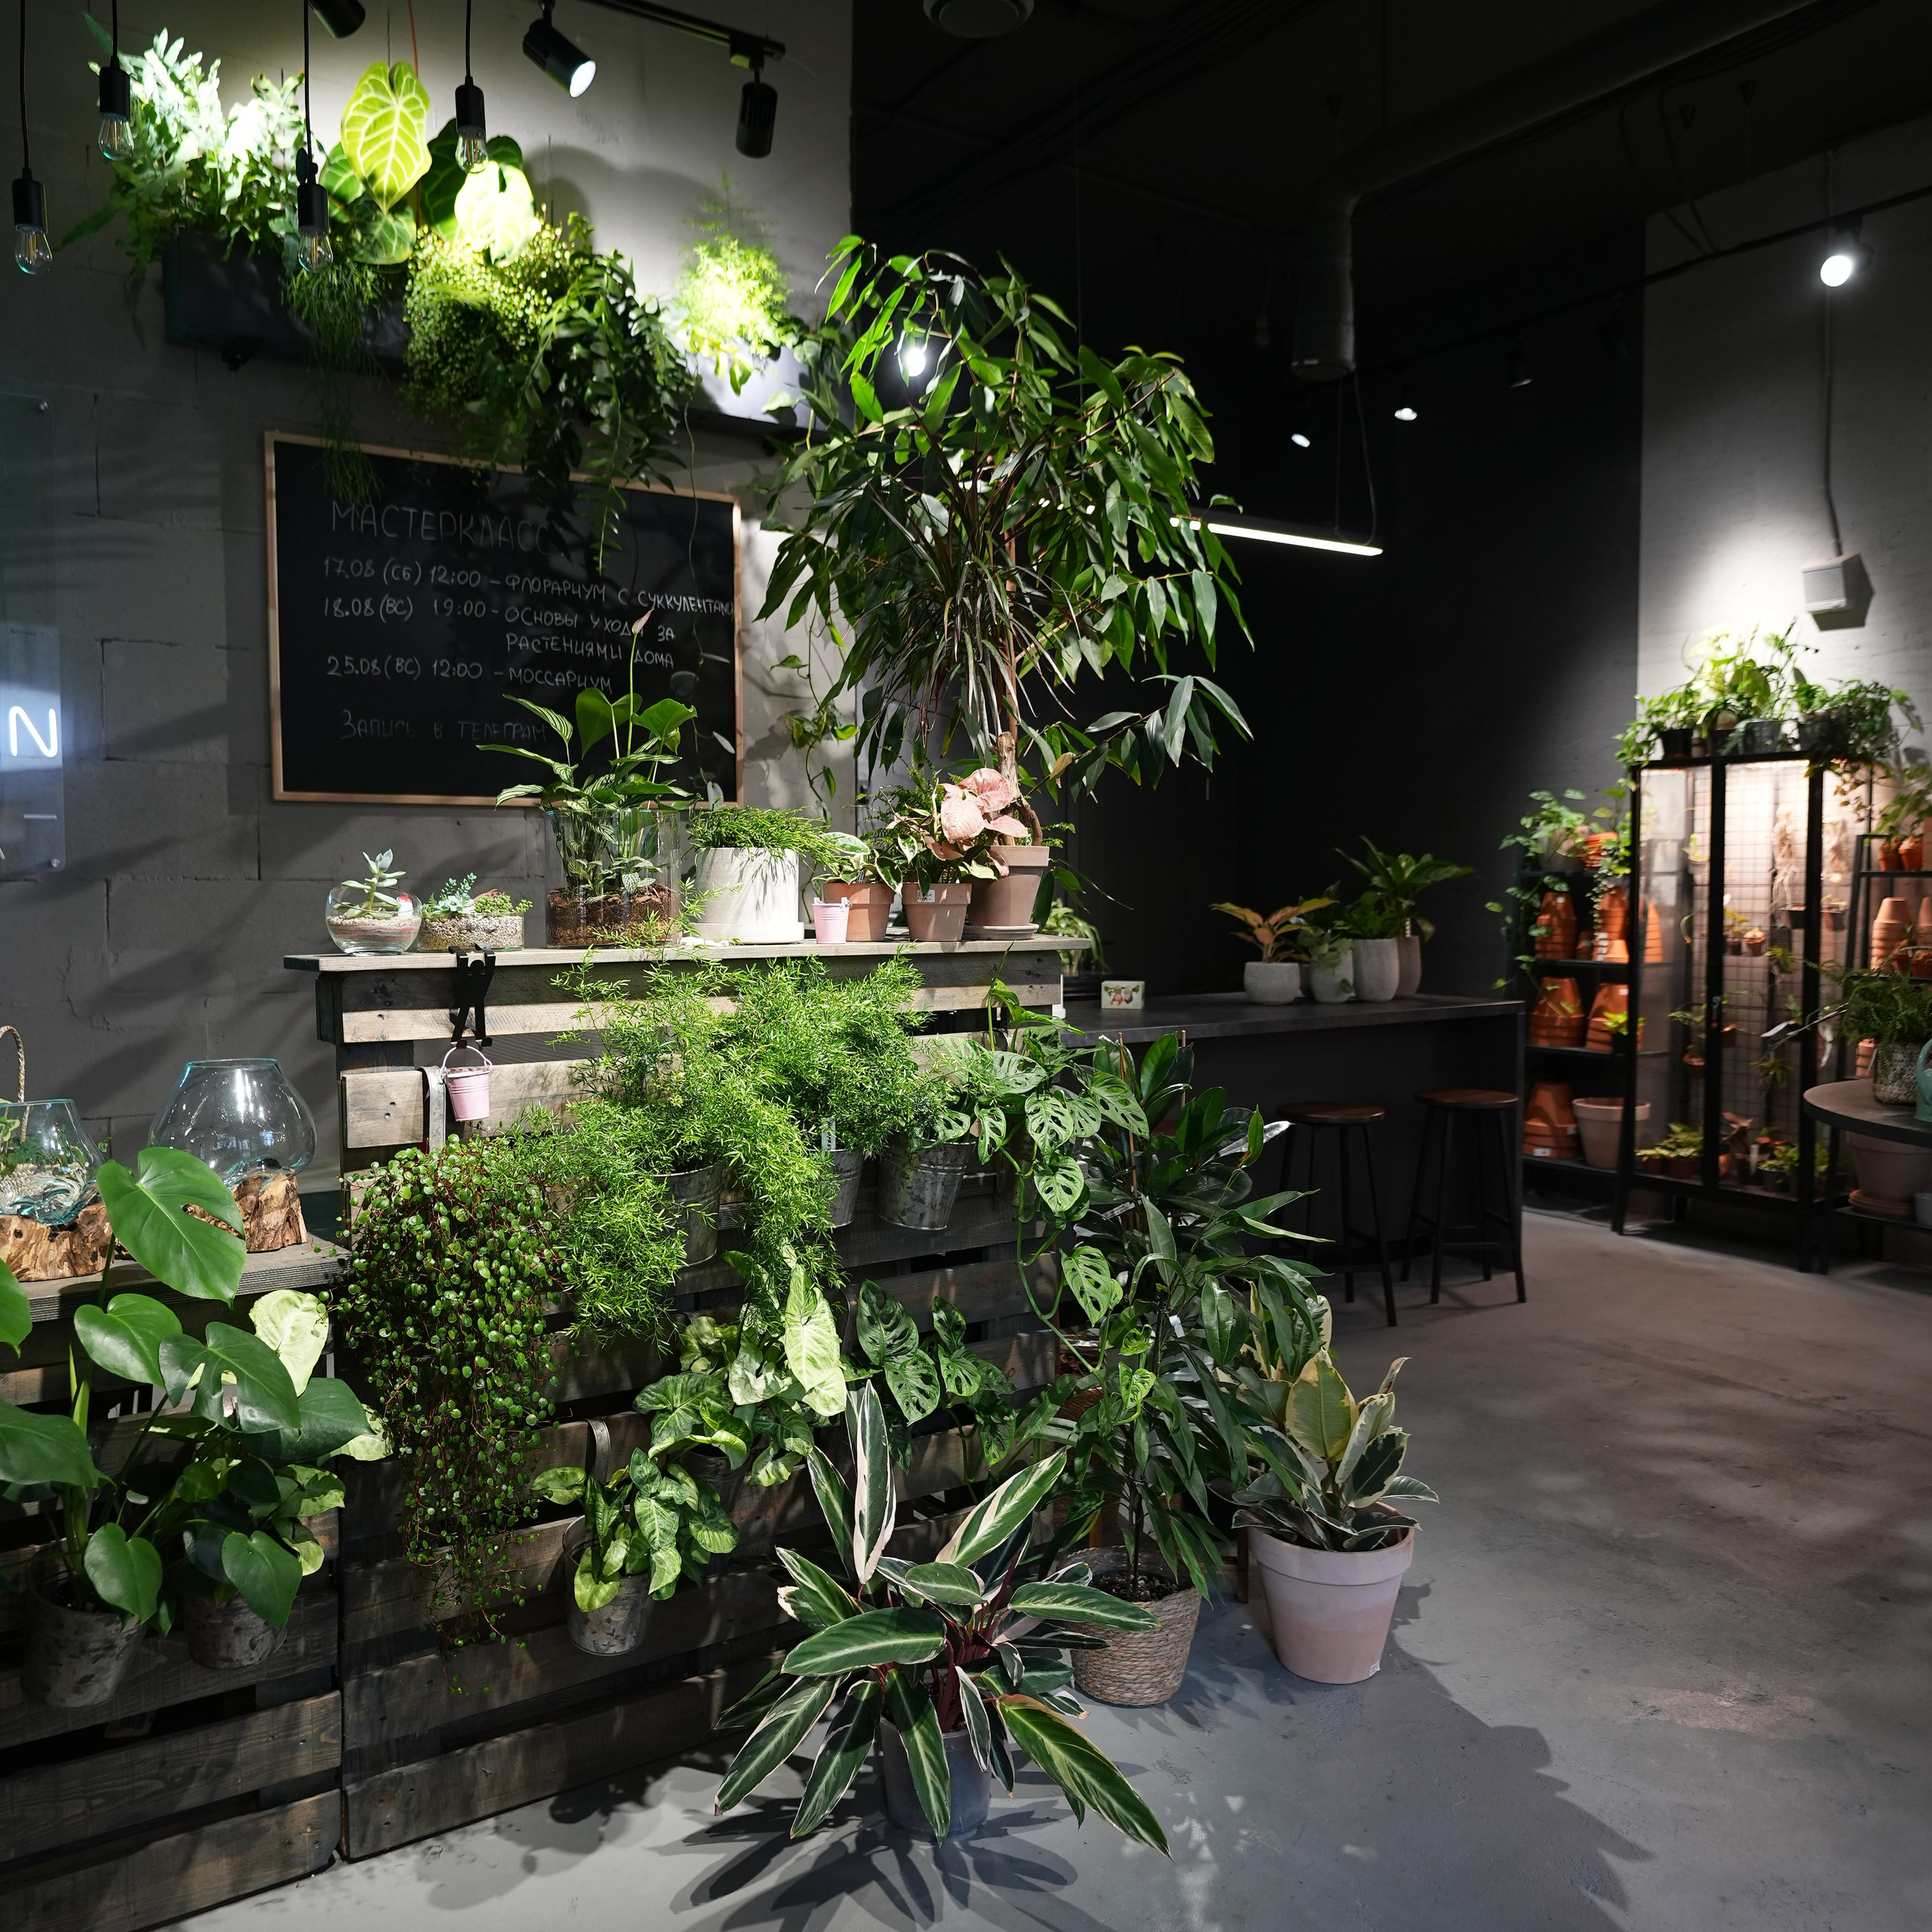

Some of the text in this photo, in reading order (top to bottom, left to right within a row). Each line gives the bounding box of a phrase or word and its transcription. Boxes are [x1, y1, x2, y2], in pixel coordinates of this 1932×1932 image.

[332, 500, 549, 556] МАСТЕРКЛАСС
[324, 555, 375, 579] 17.08
[383, 557, 422, 586] (СБ)
[430, 565, 481, 588] 12:00
[505, 574, 606, 602] ФЛОРАРИУМ
[617, 588, 628, 605] С
[325, 597, 375, 618] 18.08
[379, 593, 414, 623] (ВС)
[433, 598, 486, 618] 19:00
[504, 605, 577, 629] ОСНОВЫ
[657, 624, 675, 642] ЗА
[326, 655, 382, 678] 25.08
[383, 654, 422, 681] (ВС)
[432, 658, 483, 679] 12:00
[508, 667, 612, 695] МОССАРИУМ
[506, 632, 674, 669] РАСТЕНИЯМИ ДОМА
